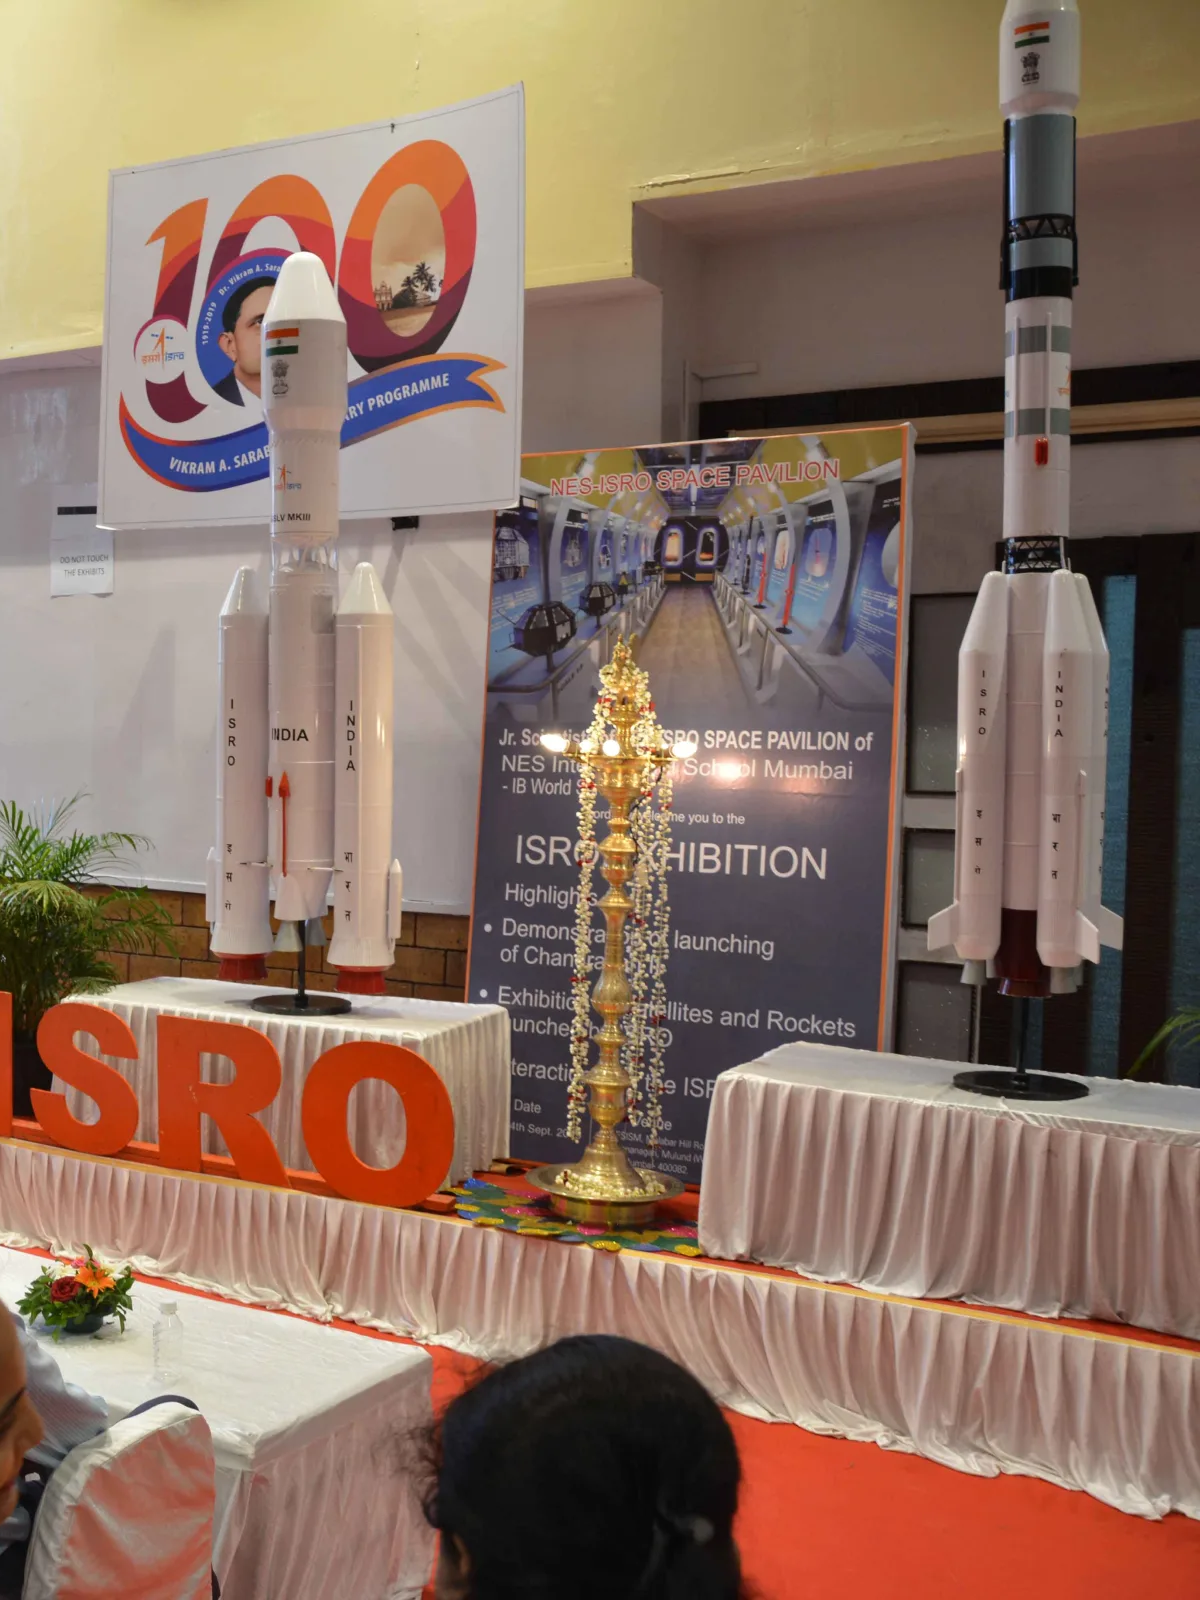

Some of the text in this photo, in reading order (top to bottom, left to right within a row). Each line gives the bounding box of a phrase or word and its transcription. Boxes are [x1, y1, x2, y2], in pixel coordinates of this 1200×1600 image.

[218, 263, 281, 296] Dr. Vikram A. Sara
[202, 302, 217, 345] 1919-2019
[165, 352, 185, 362] isro
[367, 373, 450, 412] PROGRAMME
[169, 444, 271, 474] VIKRAM A. SARAB
[550, 458, 841, 497] NES-ISRO SPACE PAVILION
[271, 514, 286, 522] SLV
[60, 554, 109, 564] DO NOT TOUCH
[978, 670, 987, 736] ISRO
[1054, 671, 1064, 738] INDIA
[228, 699, 237, 767] ISRO
[271, 728, 309, 742] INDIA
[346, 700, 356, 771] INDIA
[499, 728, 516, 746] Jr.
[704, 730, 762, 749] SPACE
[767, 731, 850, 751] PAVILION
[854, 732, 874, 751] of
[502, 755, 545, 773] NES
[764, 759, 853, 780] Mumbai
[512, 777, 526, 794] IB
[531, 778, 572, 796] World
[688, 813, 710, 826] you
[712, 812, 724, 824] to
[727, 813, 746, 825] the
[636, 840, 827, 880] XHIBITION
[504, 883, 598, 910] Highlighs
[500, 945, 519, 963] of
[674, 932, 775, 961] launching
[498, 985, 576, 1011] Exhibitio
[720, 1009, 759, 1029] and
[767, 1010, 856, 1038] Rockets
[513, 1017, 570, 1037] unche
[514, 1099, 542, 1114] Date
[527, 1124, 553, 1137] Sept.
[679, 1140, 692, 1148] Hill
